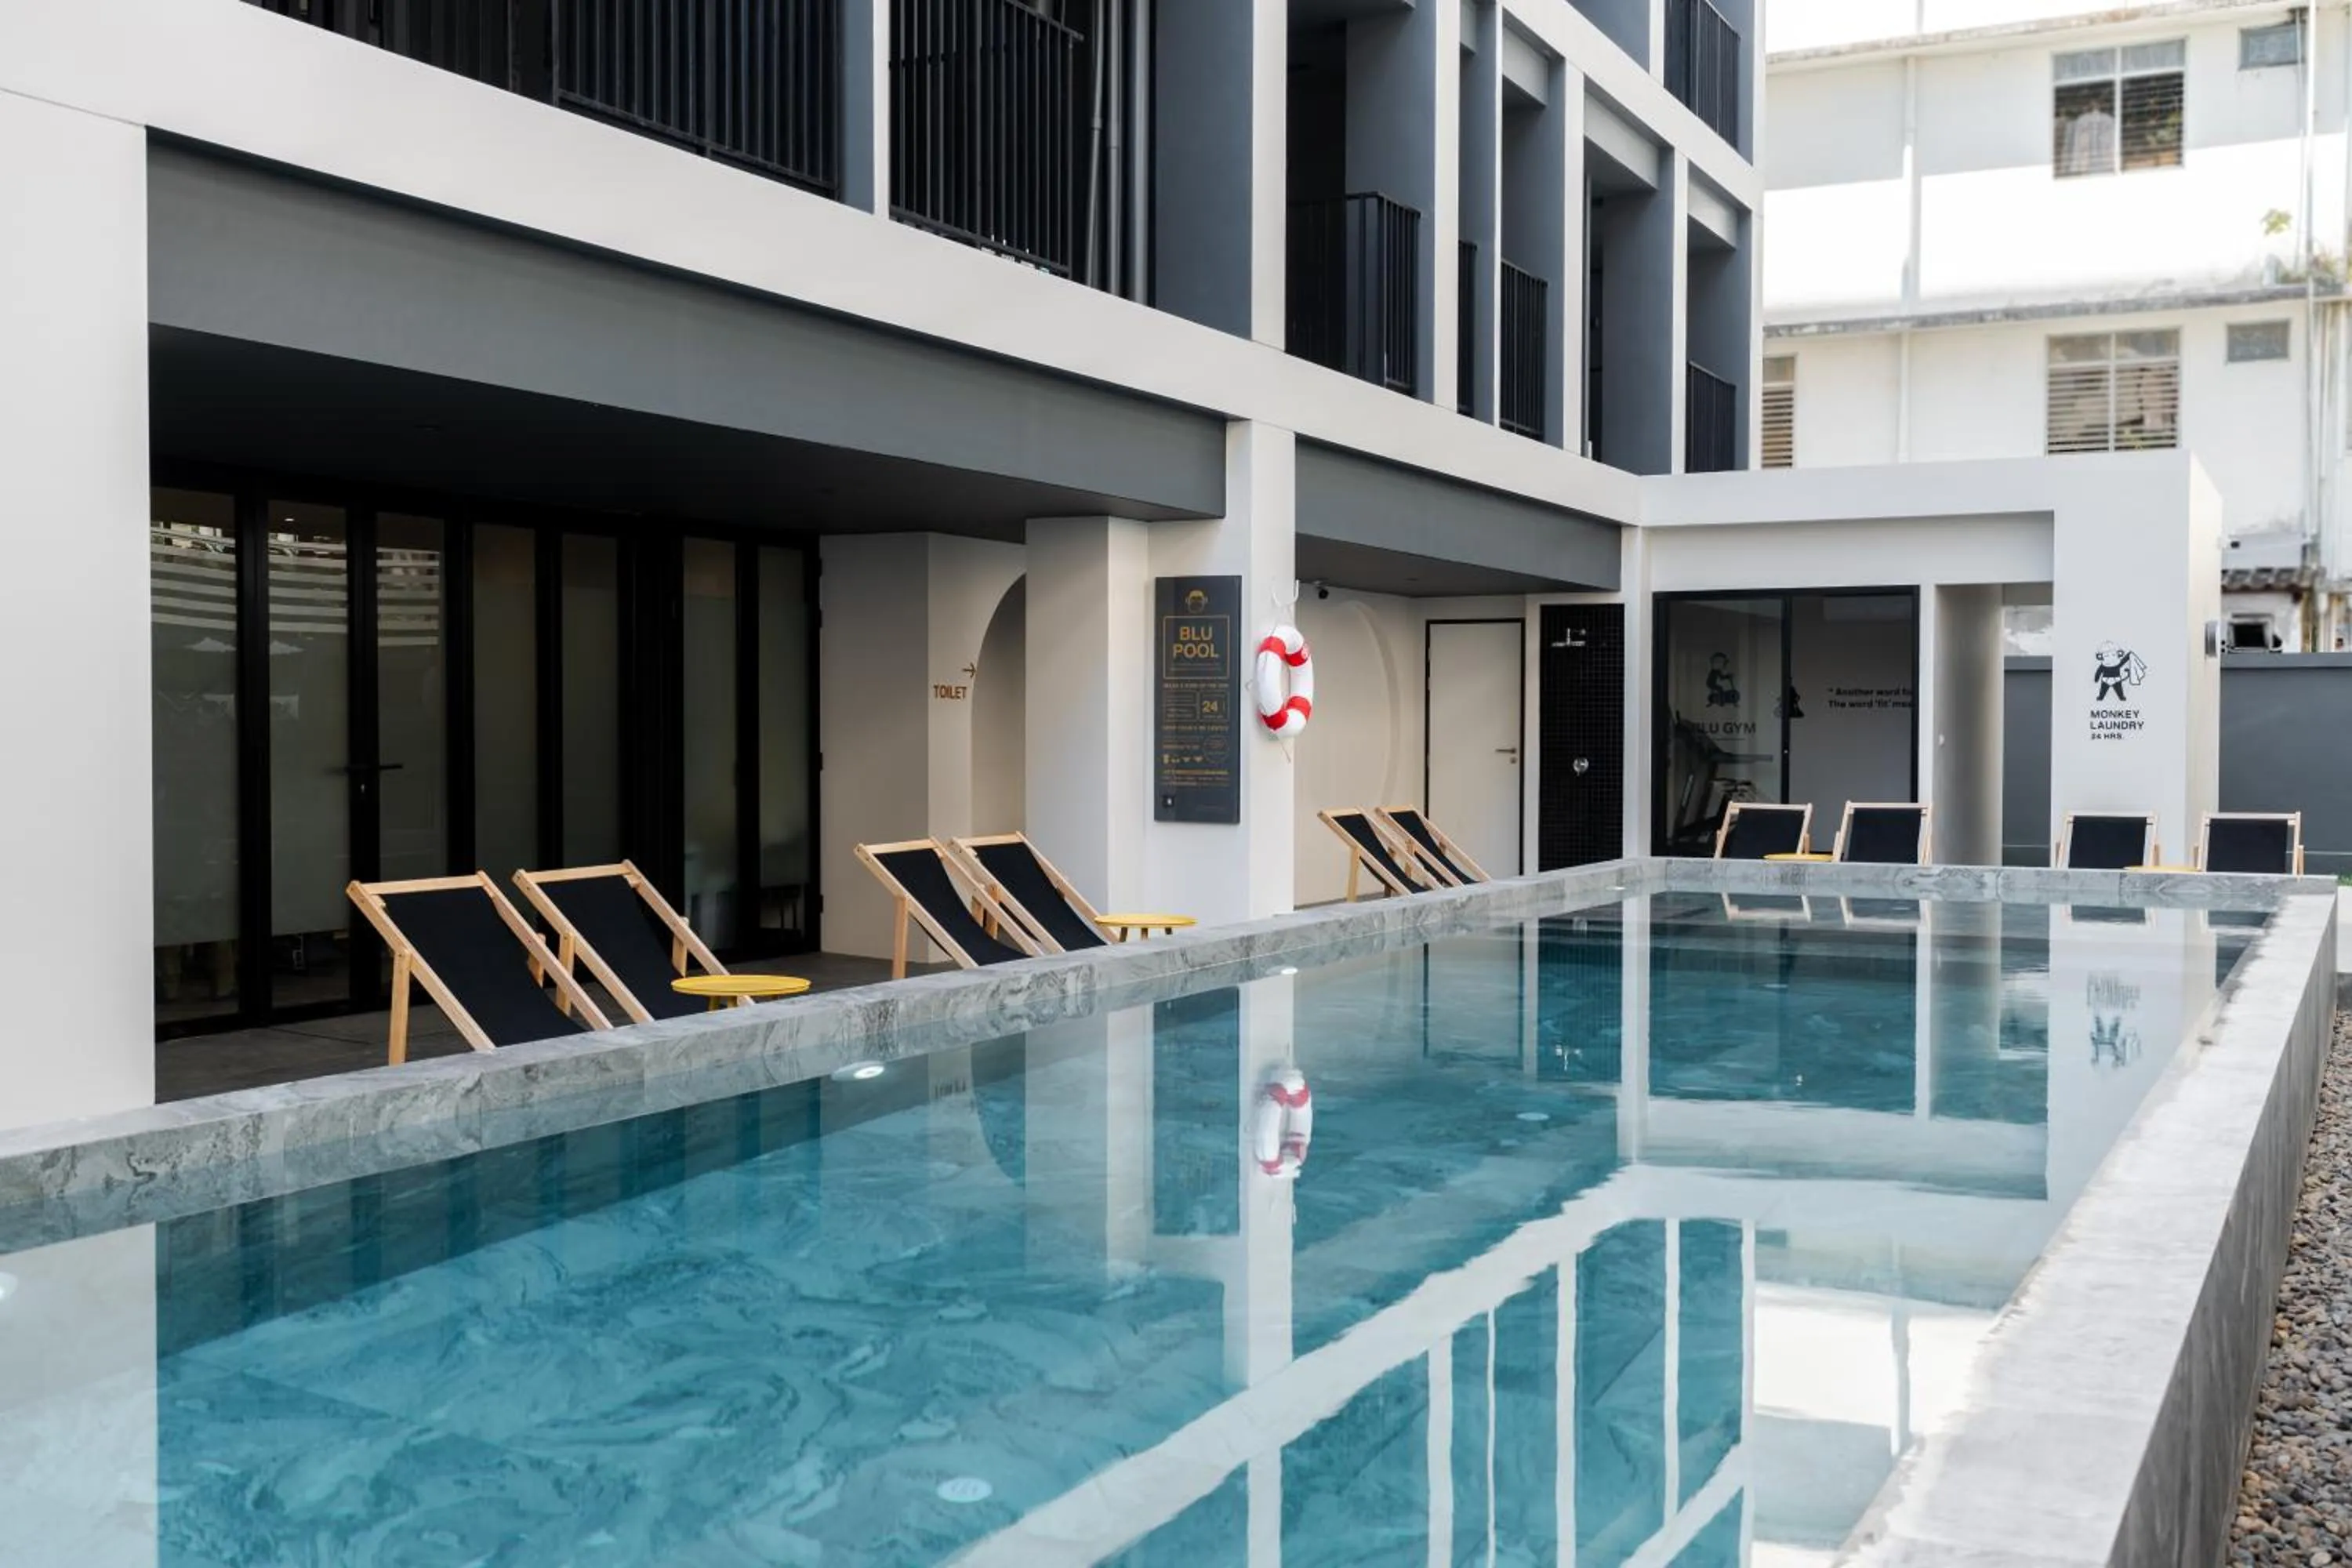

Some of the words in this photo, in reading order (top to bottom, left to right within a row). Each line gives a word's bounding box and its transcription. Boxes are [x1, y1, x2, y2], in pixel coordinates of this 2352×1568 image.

[1180, 626, 1213, 641] BLU
[1173, 643, 1219, 659] POOL
[933, 684, 967, 699] TOILET
[1202, 701, 1218, 713] 24
[1828, 699, 1846, 708] The
[2090, 710, 2140, 719] MONKEY
[1693, 722, 1719, 735] LU
[1722, 722, 1757, 735] GYM
[2090, 720, 2144, 730] LAUNDRY
